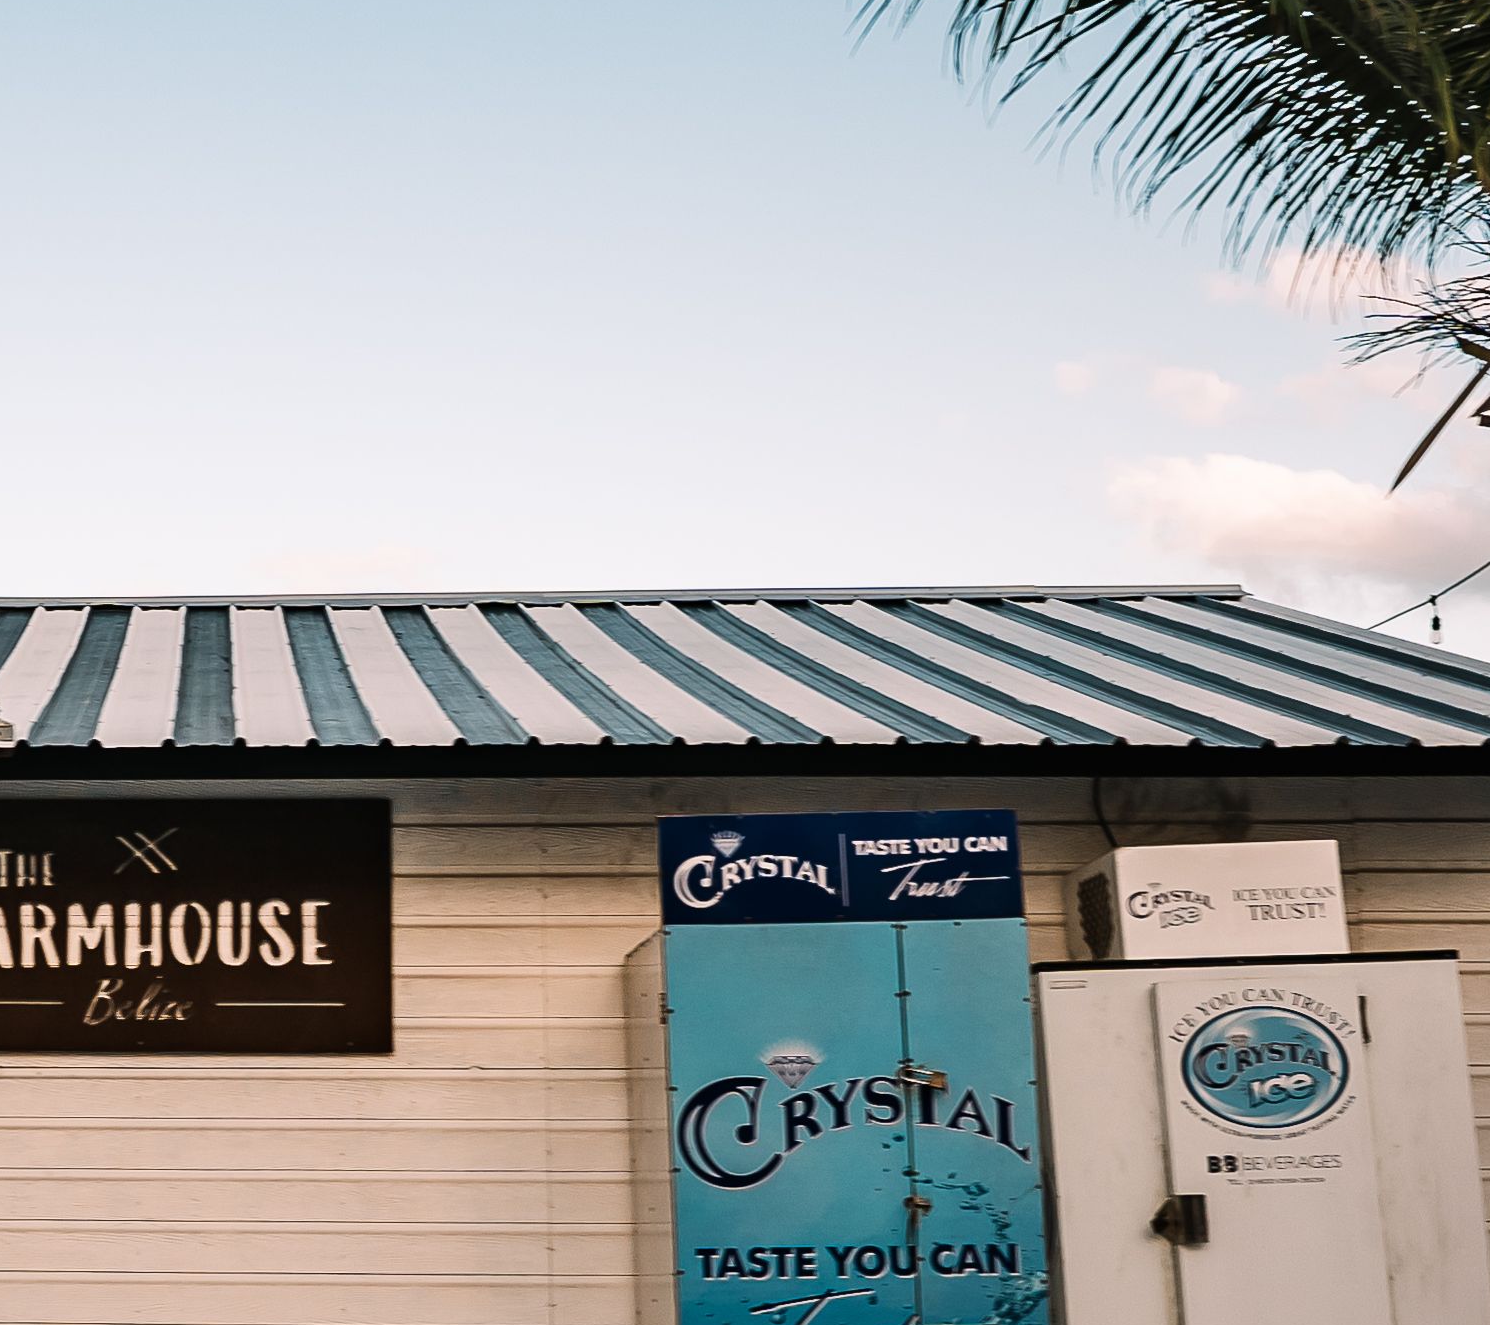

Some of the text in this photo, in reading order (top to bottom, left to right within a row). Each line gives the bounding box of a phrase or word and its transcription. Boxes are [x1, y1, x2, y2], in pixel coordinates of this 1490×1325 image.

[851, 836, 1009, 856] TASTE YOU CAN
[881, 857, 1011, 901] Trust
[1260, 888, 1299, 901] YOU
[1301, 886, 1338, 899] CAN
[1245, 901, 1327, 921] TRUST!
[81, 975, 195, 1026] Belize
[1169, 988, 1357, 1043] ICE YOU CAN TRUST!
[1241, 1154, 1343, 1171] BEVERAGES
[694, 1242, 1022, 1280] TASTE YOU CAN
